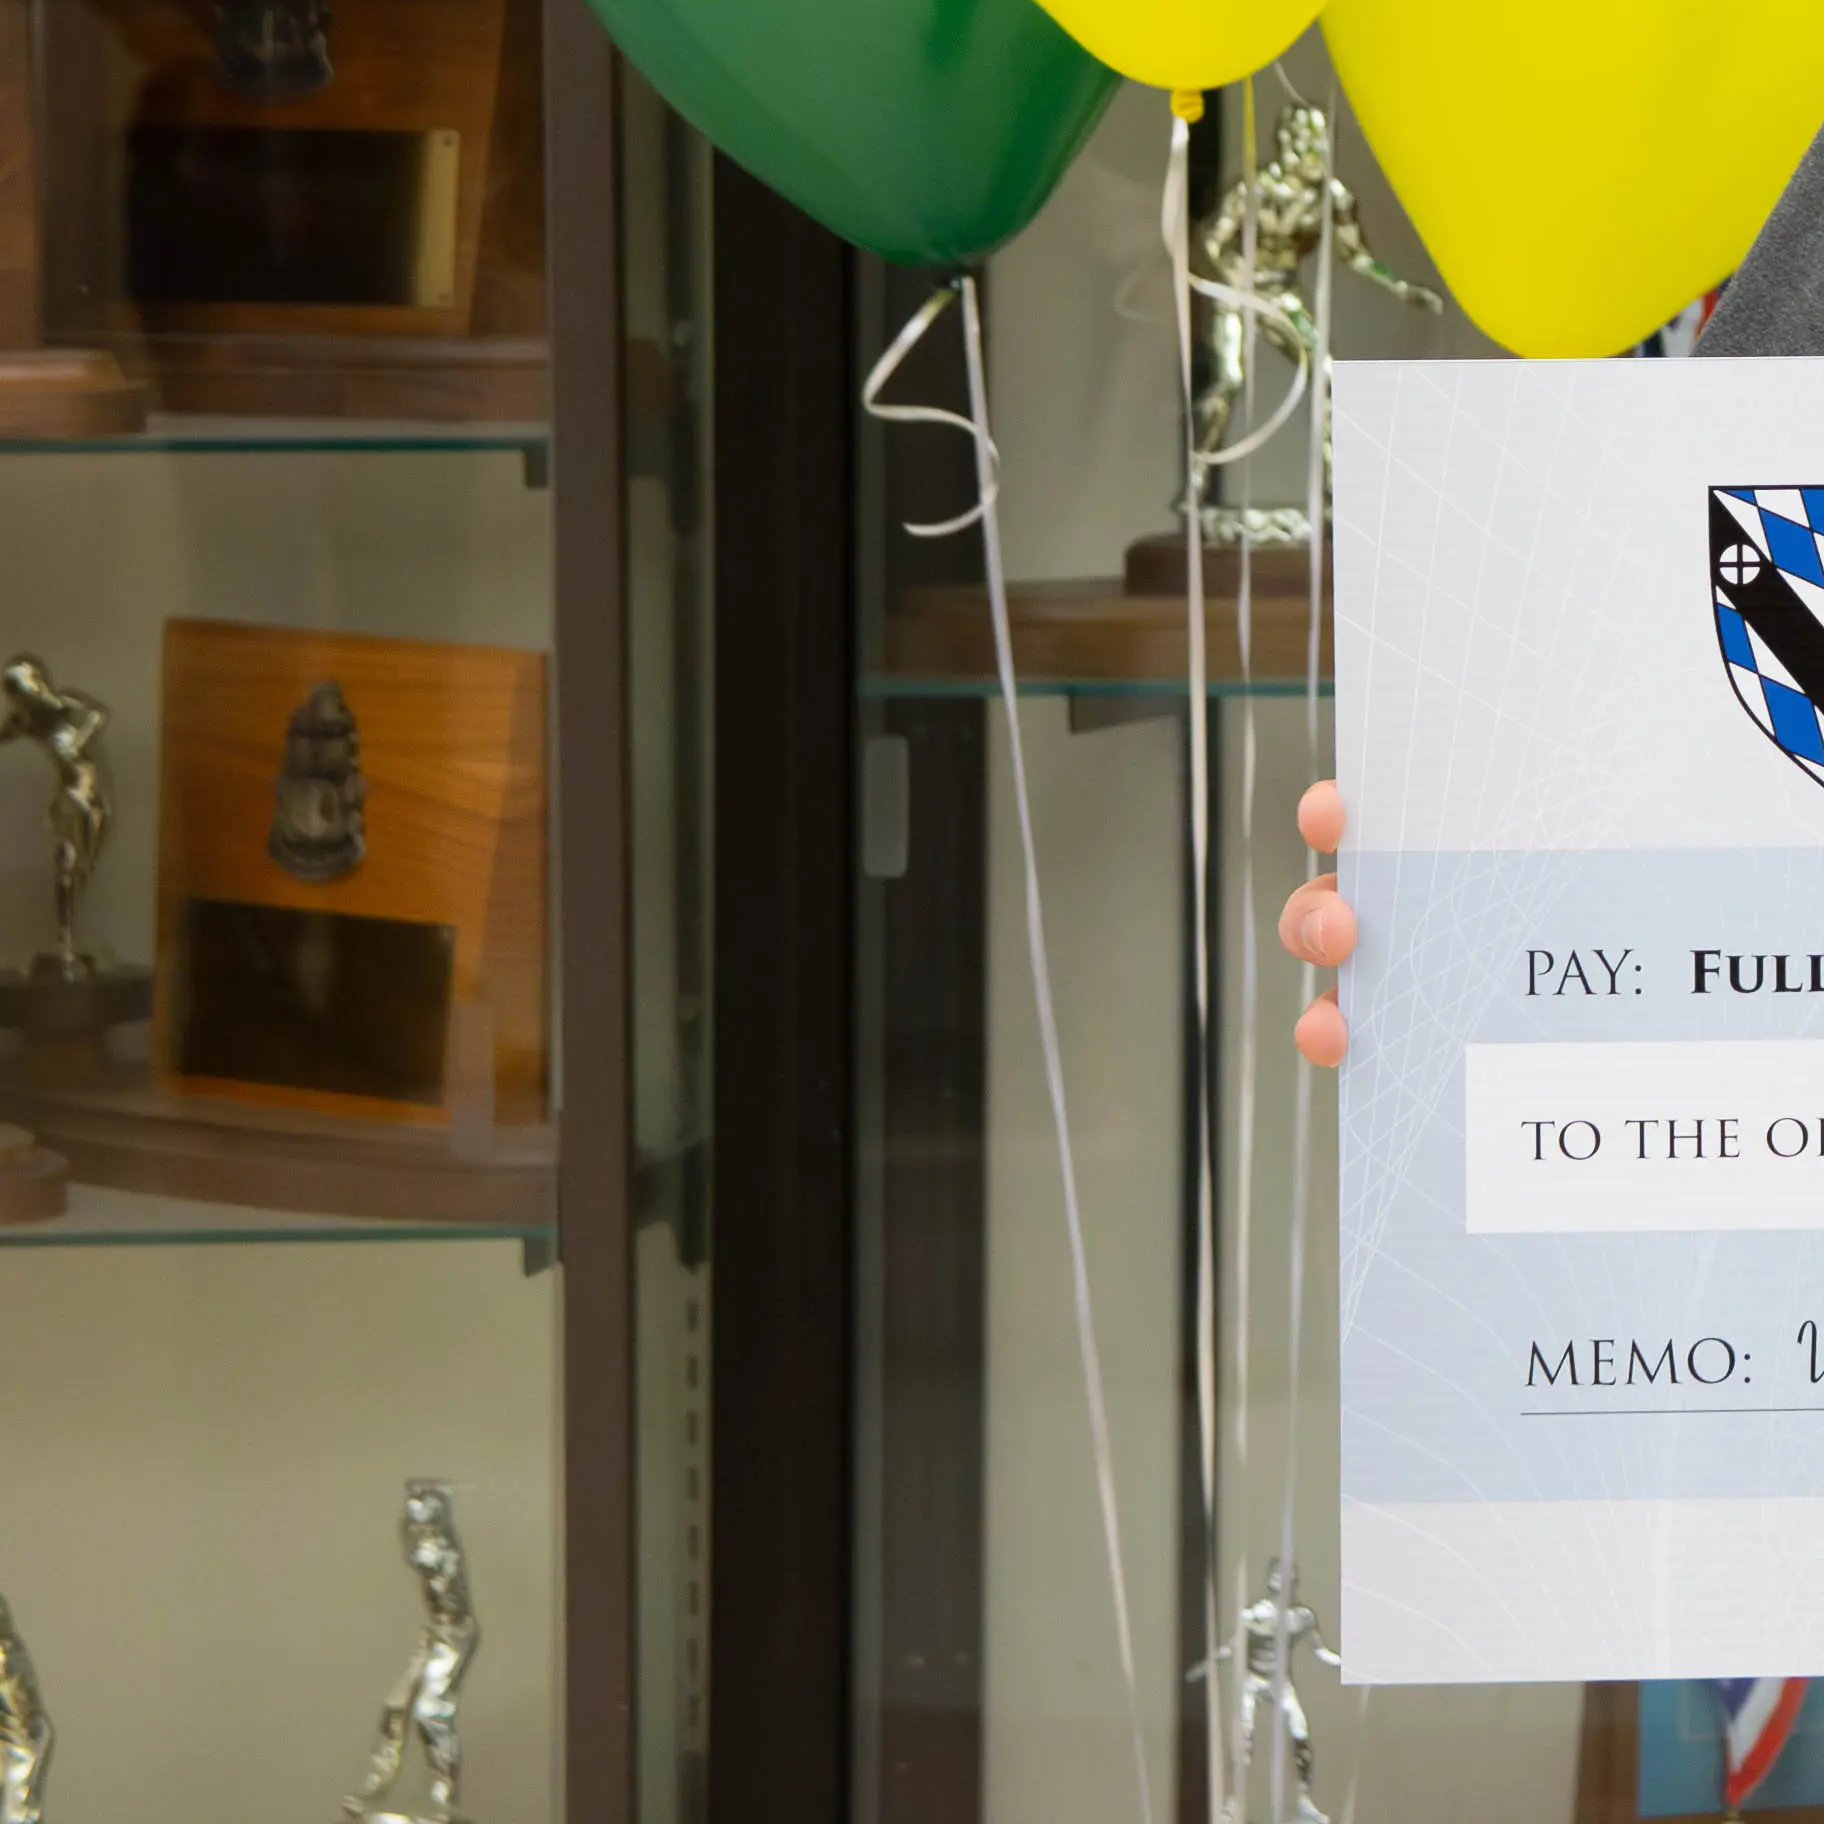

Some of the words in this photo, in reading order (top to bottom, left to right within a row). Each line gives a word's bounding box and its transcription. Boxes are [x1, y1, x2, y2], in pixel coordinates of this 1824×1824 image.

[1525, 948, 1643, 997] PAY:
[1520, 1120, 1602, 1161] TO
[1624, 1118, 1741, 1160] THE
[1525, 1337, 1753, 1388] MEMO:
